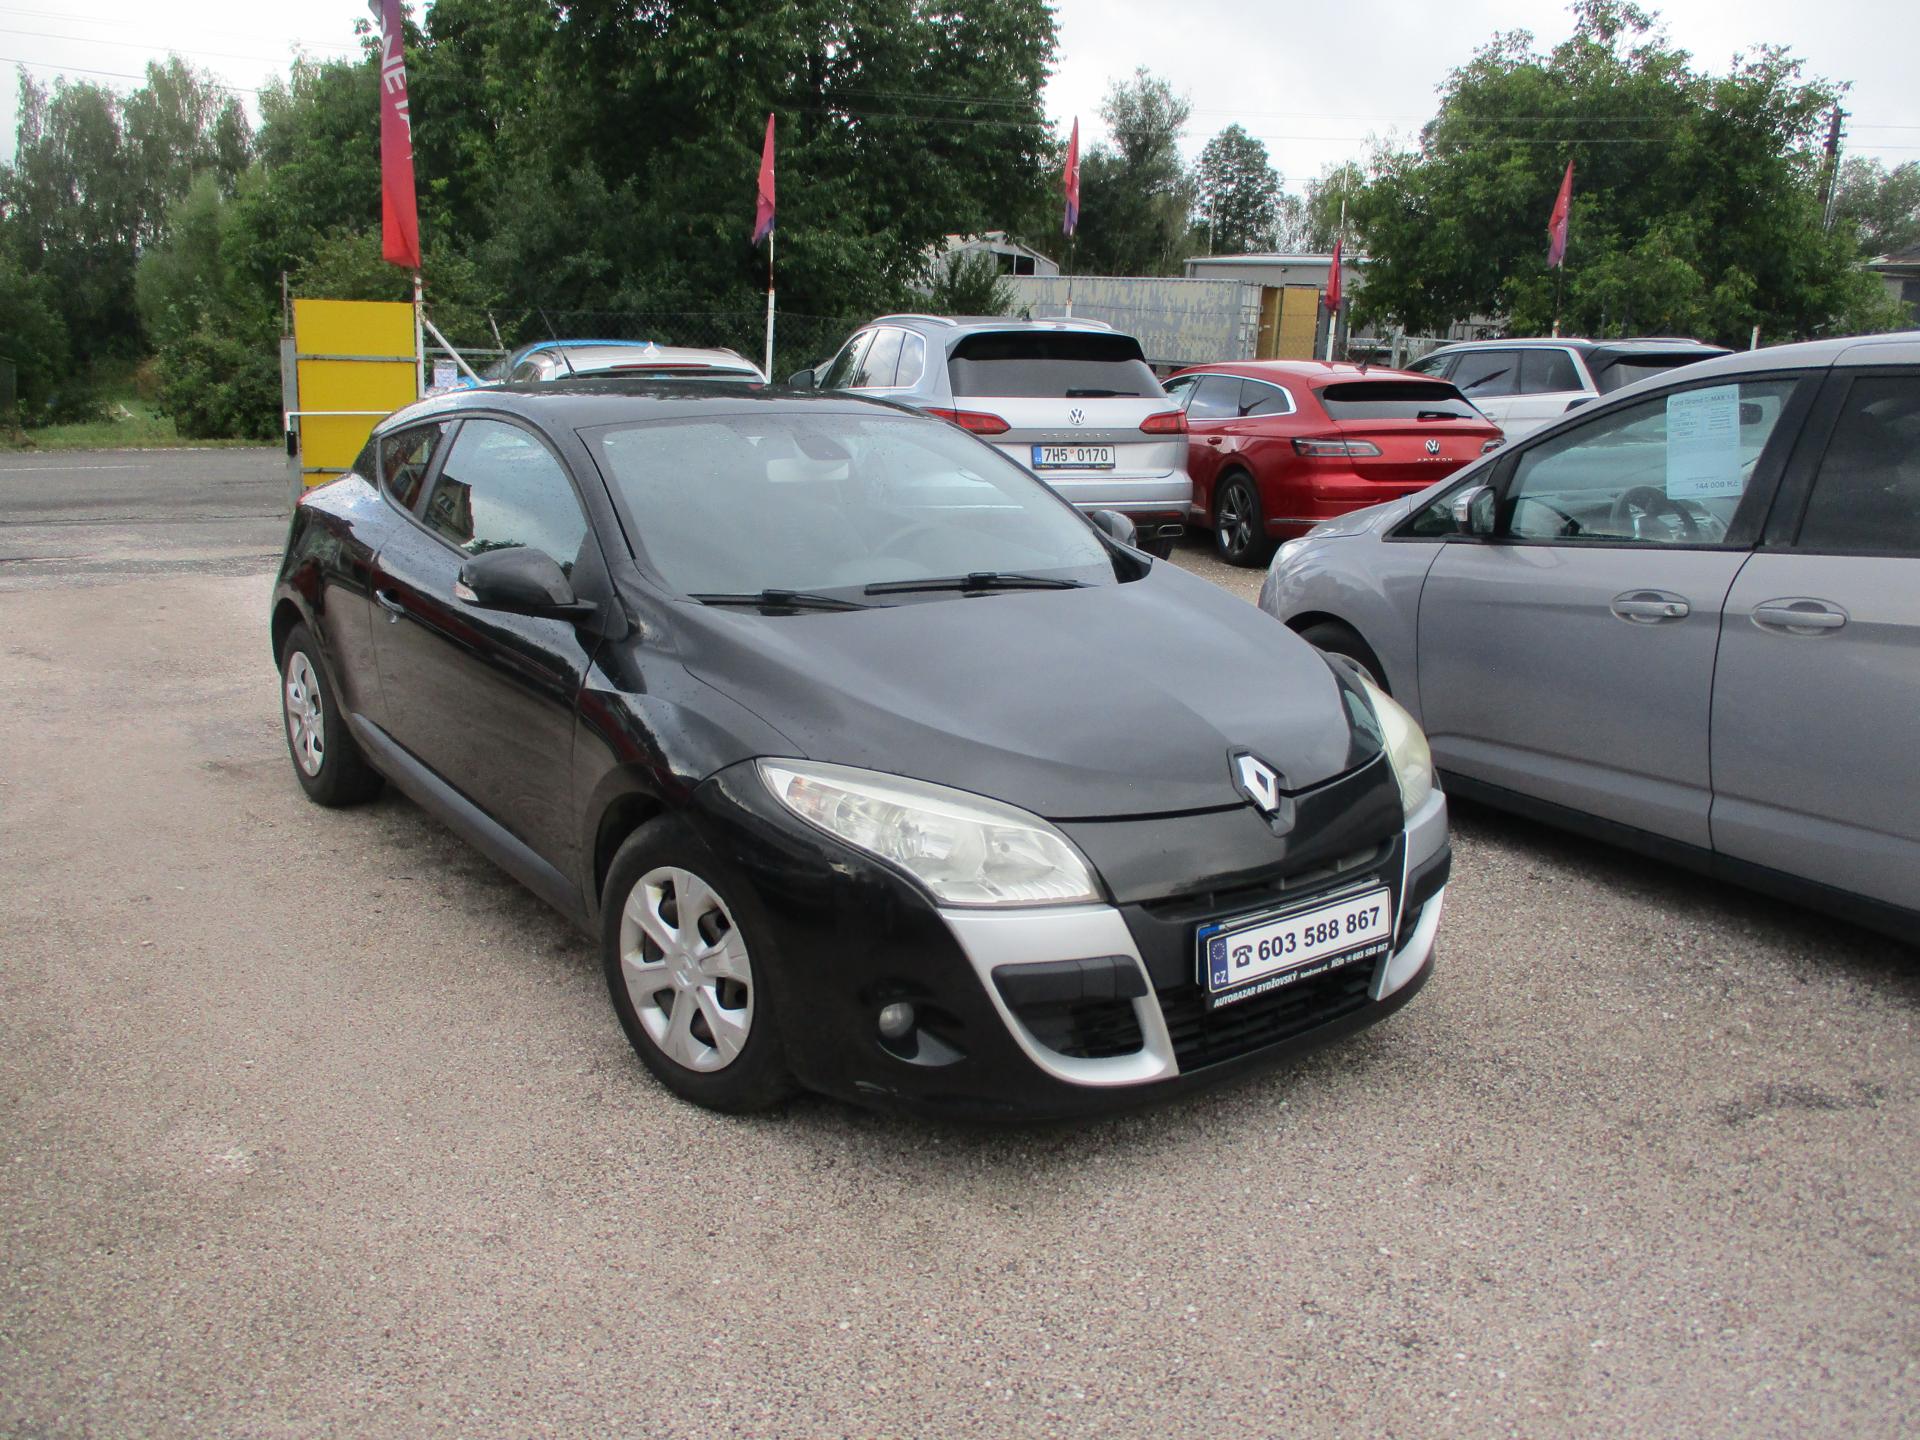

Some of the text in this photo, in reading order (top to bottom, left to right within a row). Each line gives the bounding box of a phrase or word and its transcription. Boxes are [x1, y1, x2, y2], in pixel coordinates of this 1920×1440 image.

[1044, 448, 1108, 462] 7H5 0170
[1258, 906, 1380, 962] 603 588 867
[1213, 986, 1256, 1009] AUTOBAZAR
[1256, 970, 1298, 994] BYDŽOVSKÝ
[1214, 970, 1227, 985] CZ
